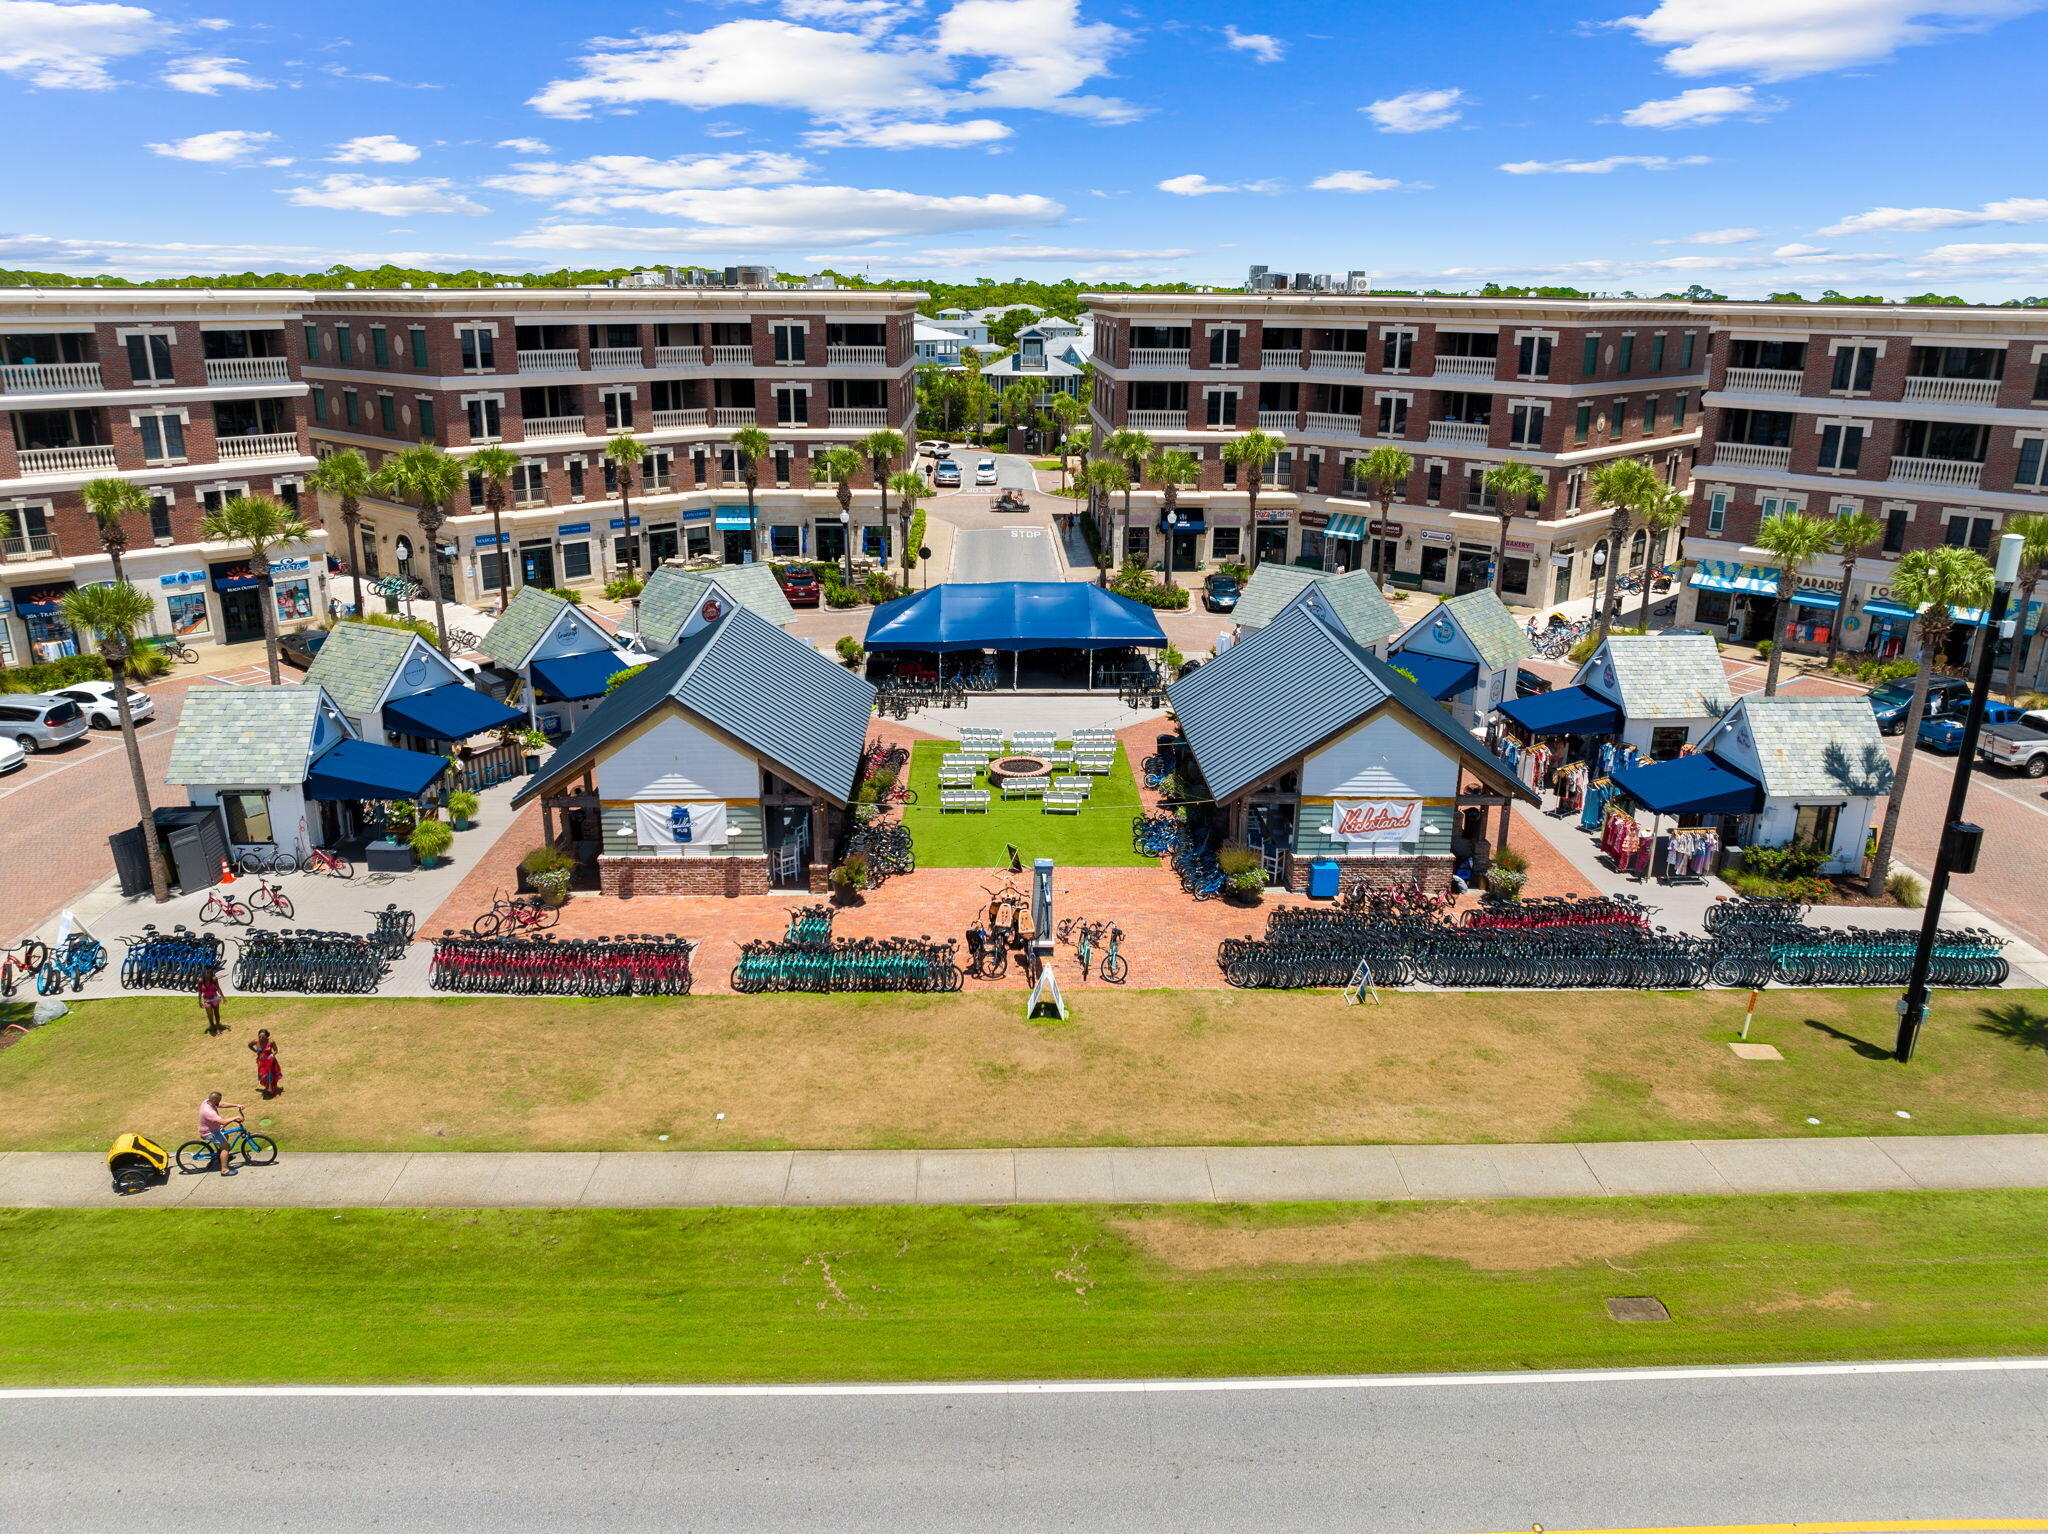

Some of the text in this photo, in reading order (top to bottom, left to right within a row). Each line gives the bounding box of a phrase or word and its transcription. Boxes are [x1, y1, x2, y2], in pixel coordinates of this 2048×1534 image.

[1011, 530, 1041, 538] STOP
[275, 563, 301, 573] COSTA
[1796, 577, 1844, 591] PARADIS
[1338, 803, 1415, 834] Kickstand
